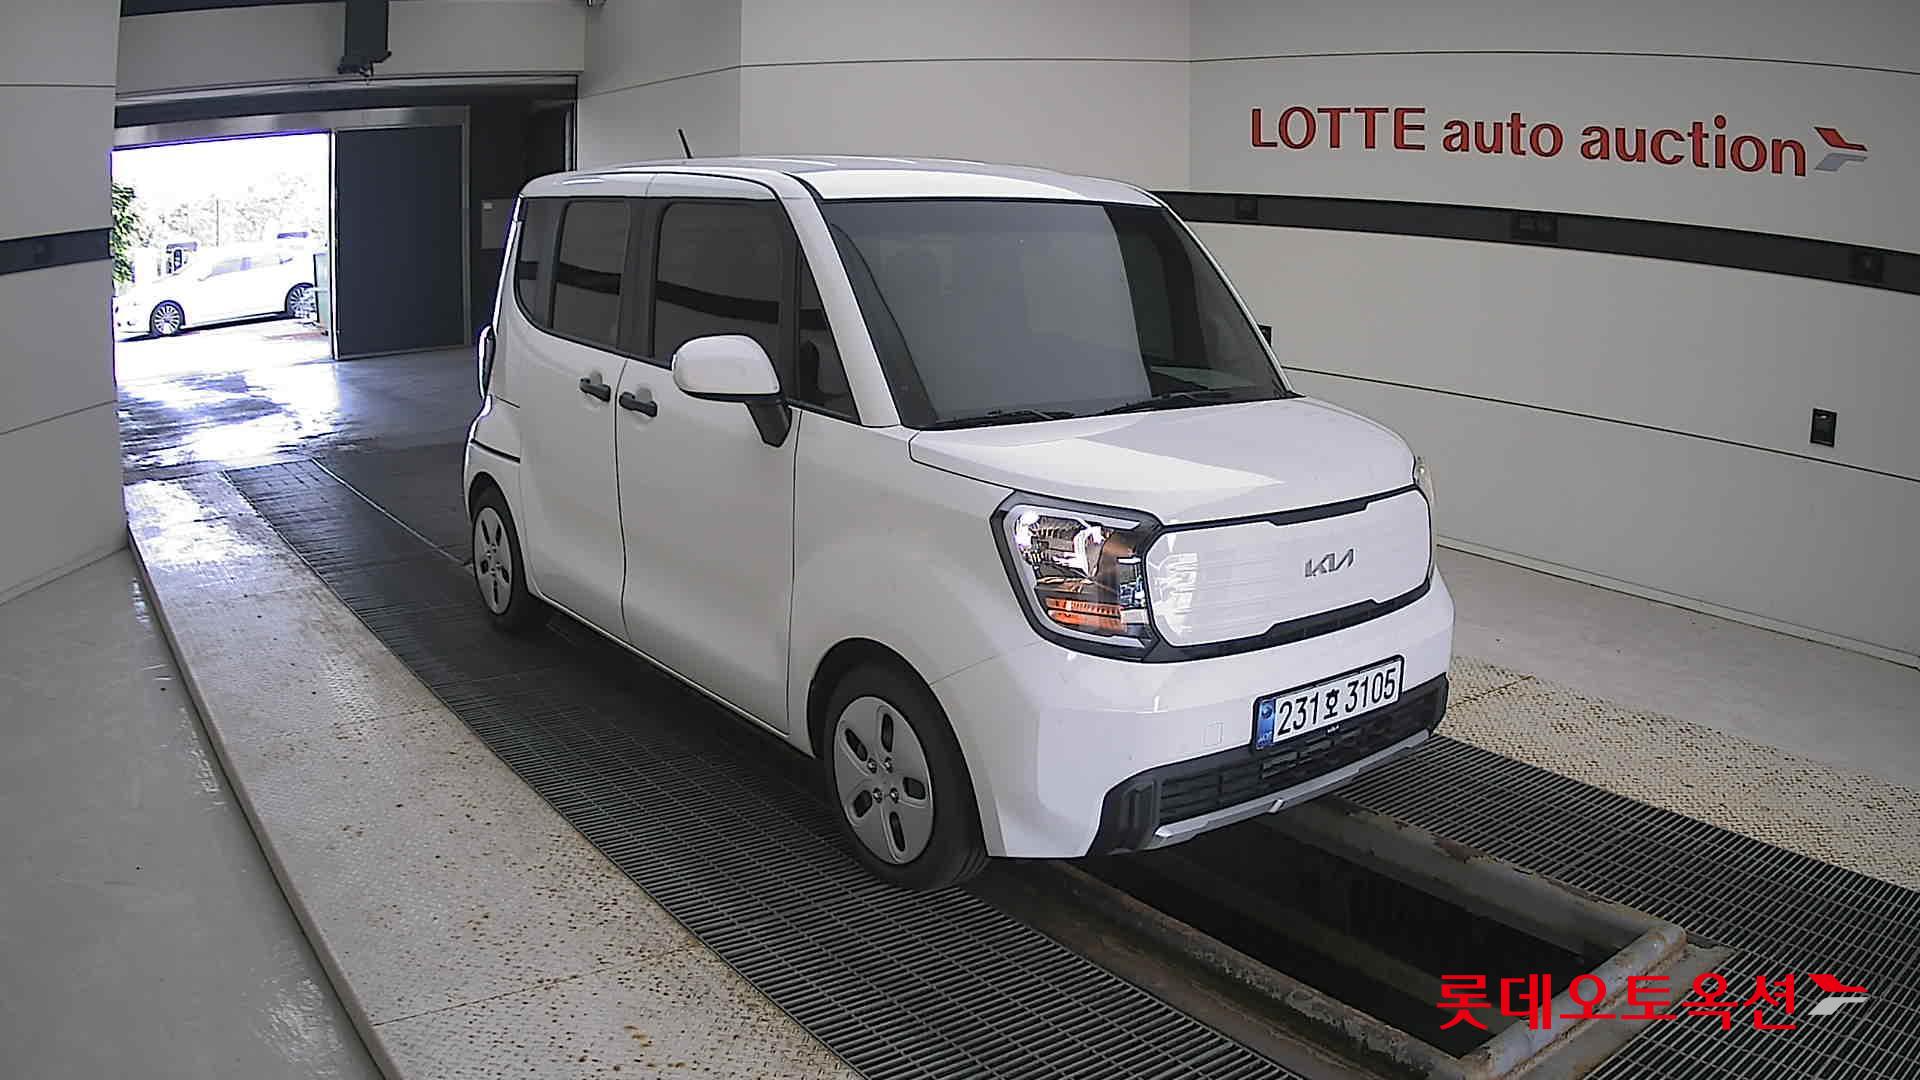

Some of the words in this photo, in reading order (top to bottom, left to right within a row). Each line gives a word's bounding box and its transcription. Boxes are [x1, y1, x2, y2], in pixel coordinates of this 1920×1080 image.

[1251, 106, 1426, 151] LOTTE
[1442, 112, 1565, 158] auto
[1579, 114, 1807, 178] auction
[1304, 548, 1354, 578] KIA
[1345, 667, 1397, 713] 3105
